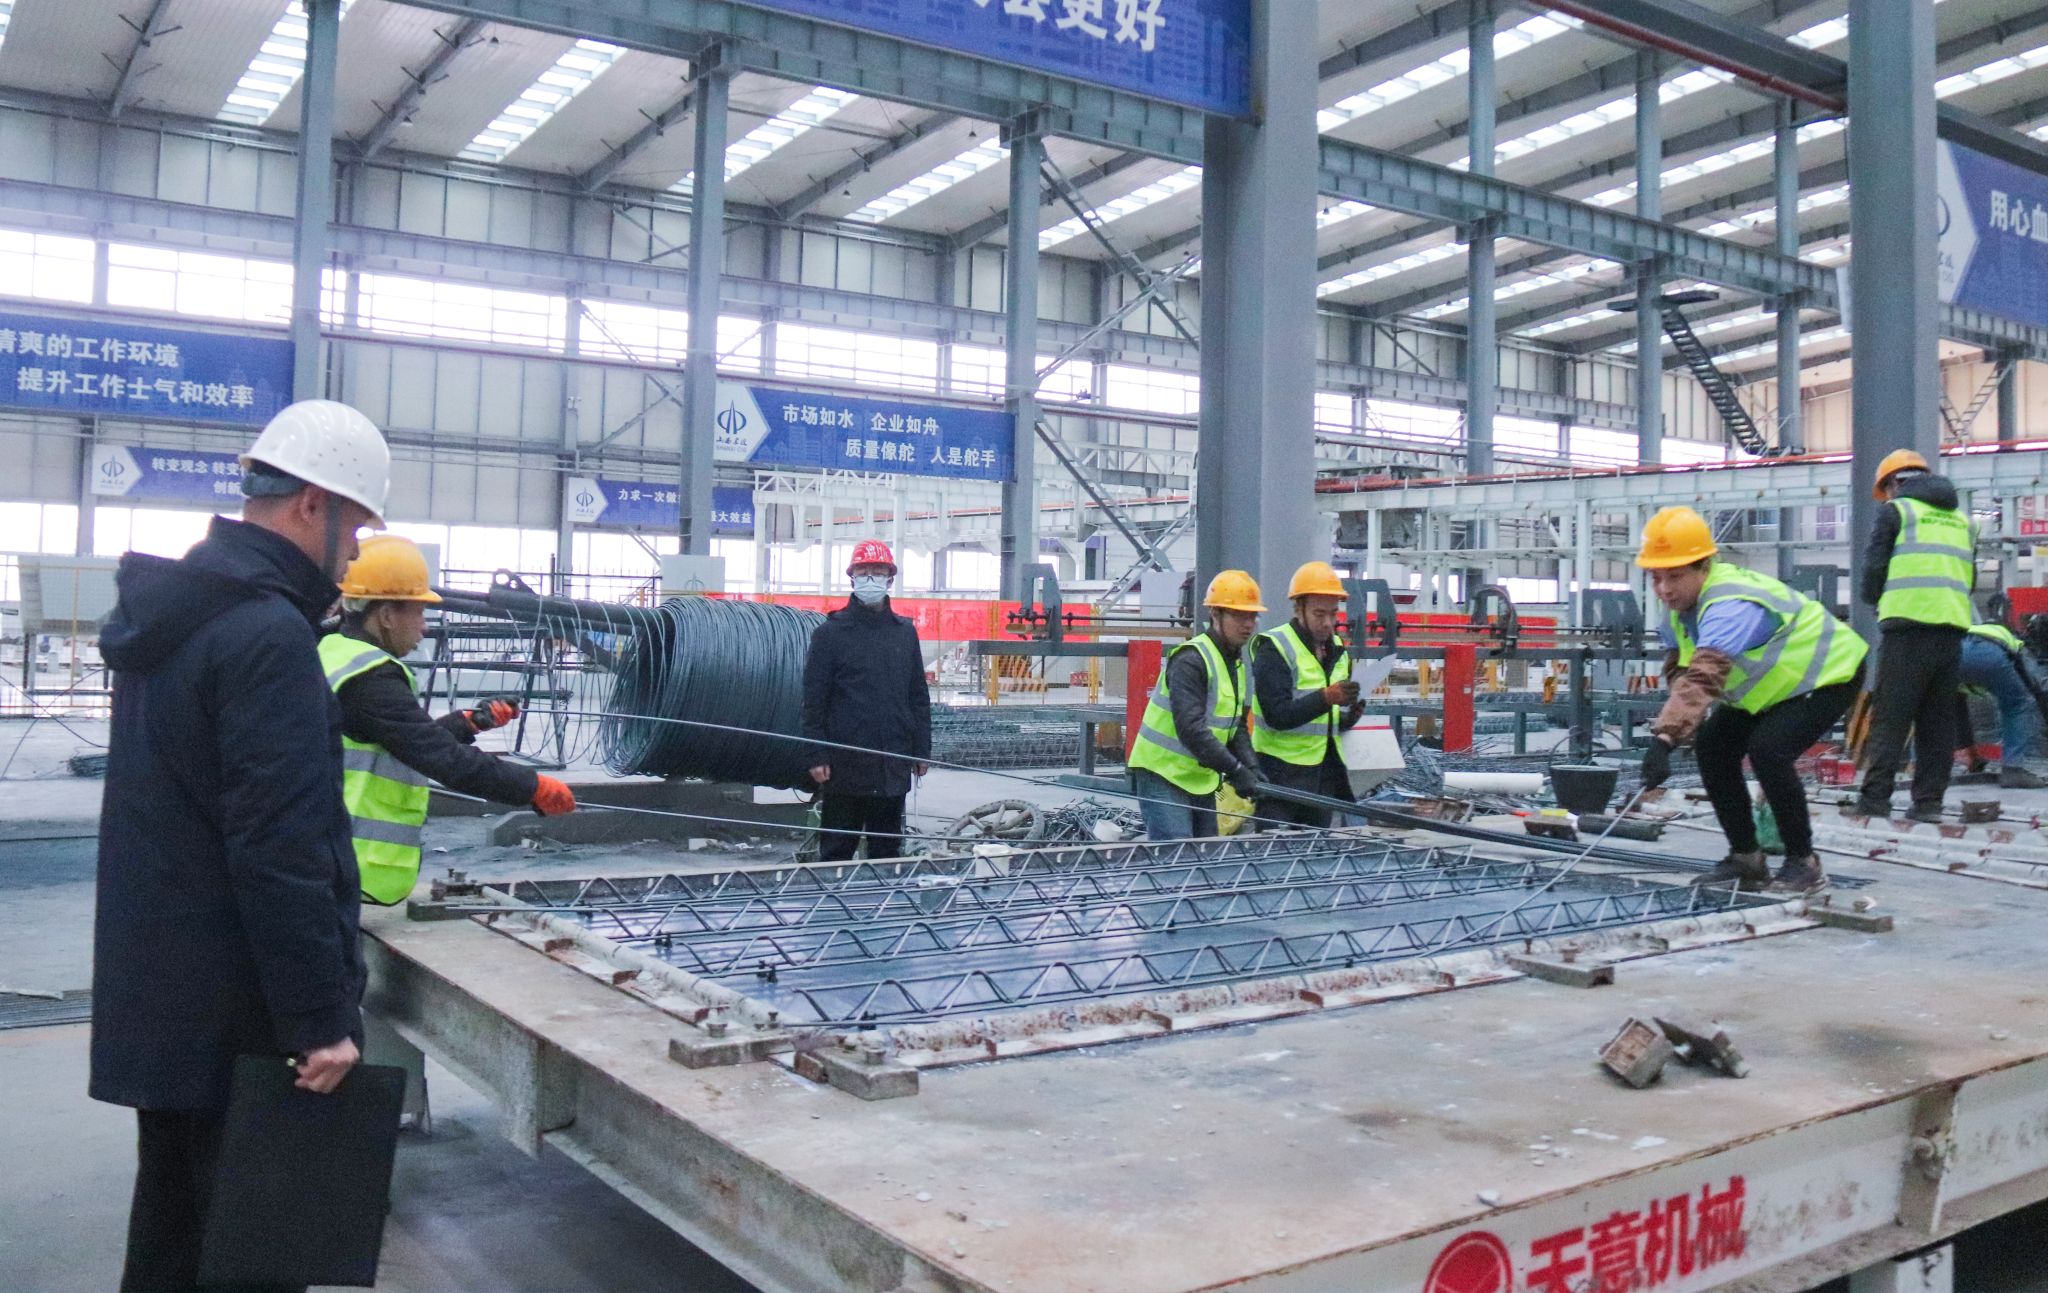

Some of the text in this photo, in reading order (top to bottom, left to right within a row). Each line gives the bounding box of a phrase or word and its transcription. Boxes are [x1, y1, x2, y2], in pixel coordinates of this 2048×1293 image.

[17, 366, 254, 408] 提升工作士气和效率
[782, 404, 940, 436] 市场如水 企业如舟
[151, 457, 245, 477] 转变观念 转变
[845, 438, 996, 468] 质量像舵 人是舵手
[618, 488, 680, 503] 力求一次做
[1526, 1175, 1746, 1293] 天意机械
